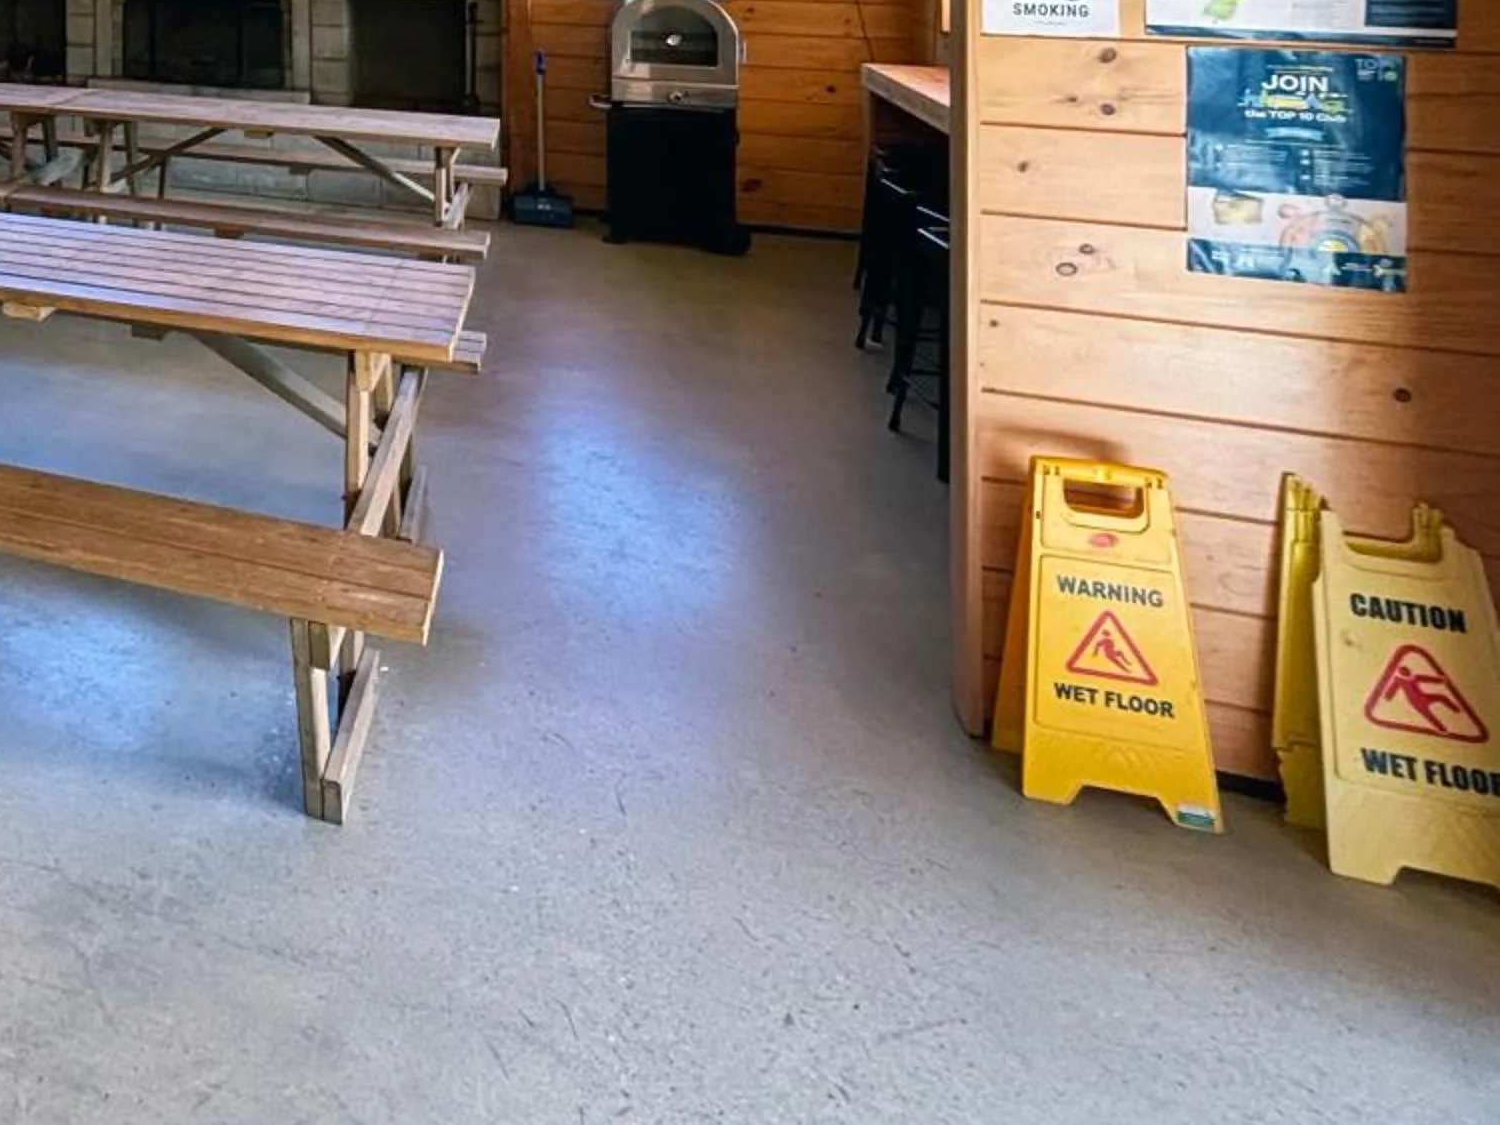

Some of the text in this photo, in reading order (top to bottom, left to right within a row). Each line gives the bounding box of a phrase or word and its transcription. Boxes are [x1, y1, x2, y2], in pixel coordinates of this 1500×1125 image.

[1013, 2, 1089, 18] SMOKING
[1261, 74, 1329, 92] JOIN
[1244, 109, 1347, 123] the TOP 10 Club
[1057, 574, 1164, 608] WARNING
[1350, 593, 1467, 633] CAUTION
[1054, 682, 1175, 719] WET FLOOR
[1360, 746, 1418, 781] WET
